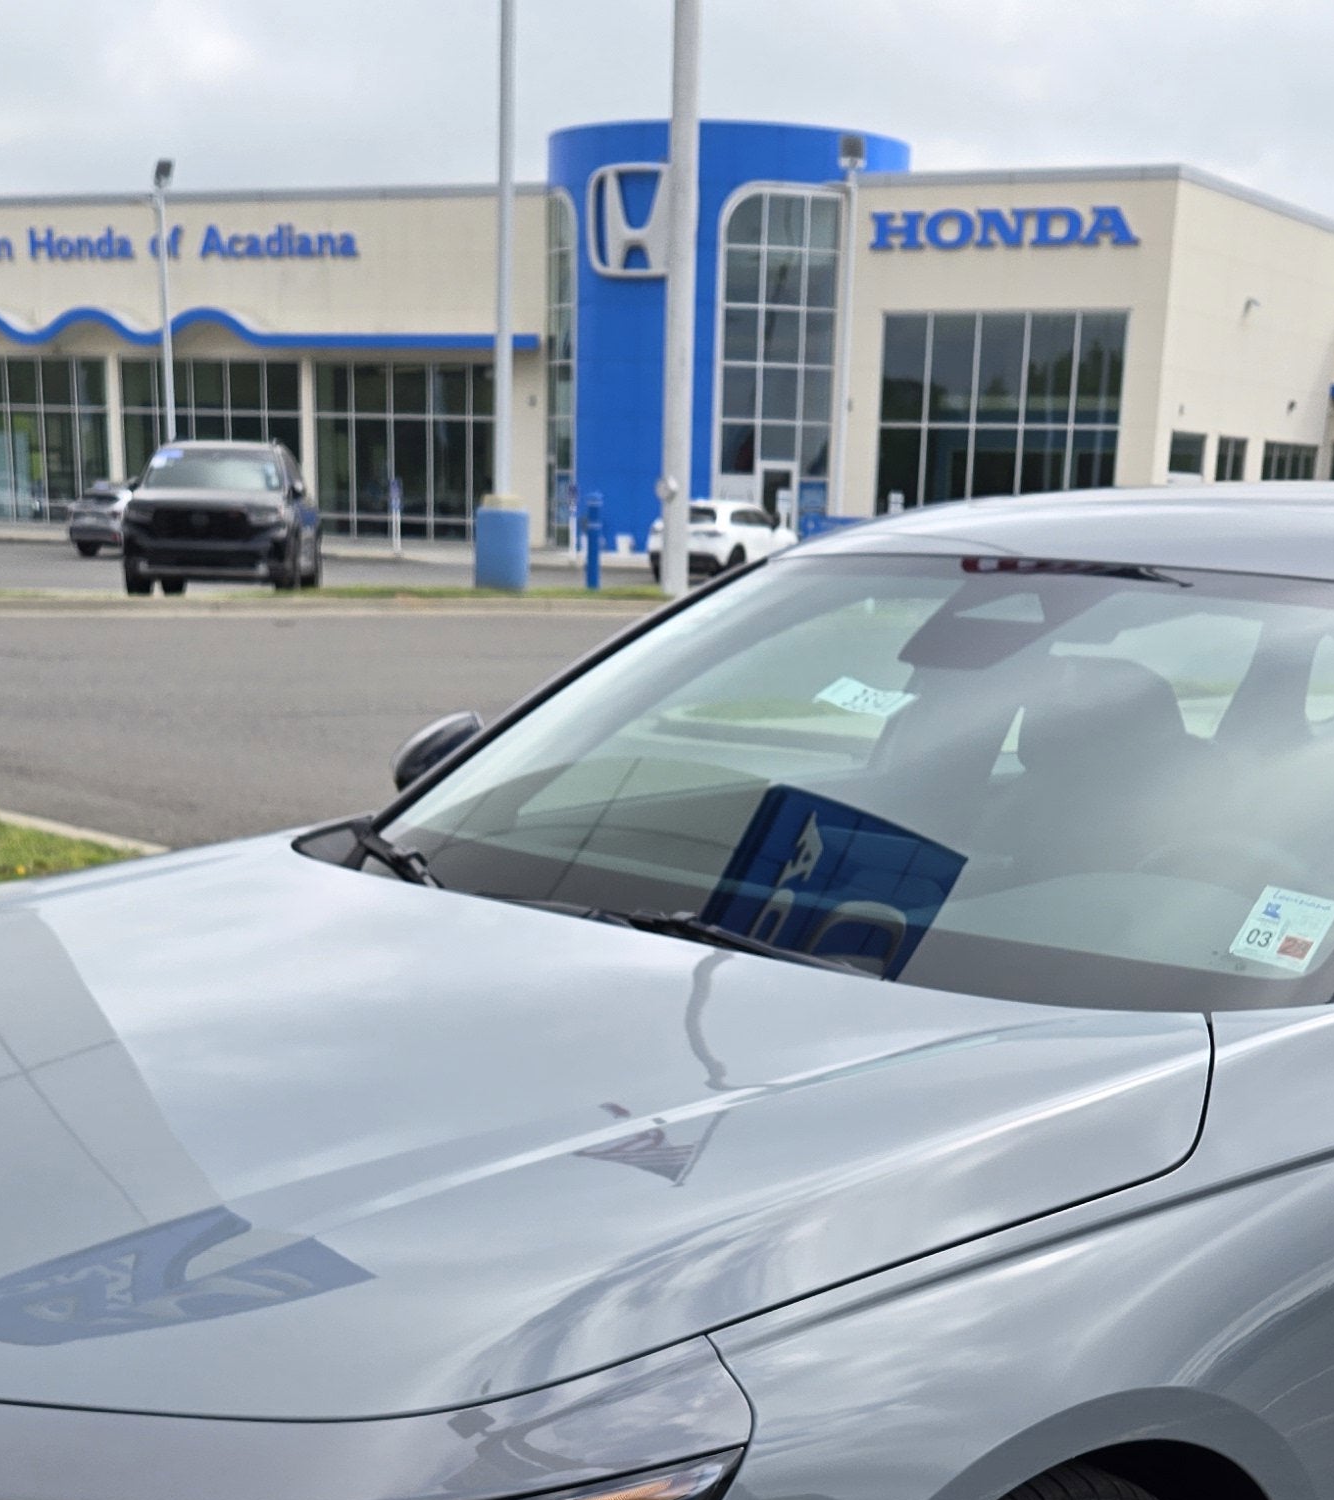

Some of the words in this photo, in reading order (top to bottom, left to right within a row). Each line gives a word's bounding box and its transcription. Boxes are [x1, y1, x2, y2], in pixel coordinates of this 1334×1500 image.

[27, 225, 136, 261] Honda
[149, 224, 183, 259] of
[199, 223, 359, 260] Acadiana
[869, 205, 1140, 251] HONDA
[1245, 927, 1273, 948] 03
